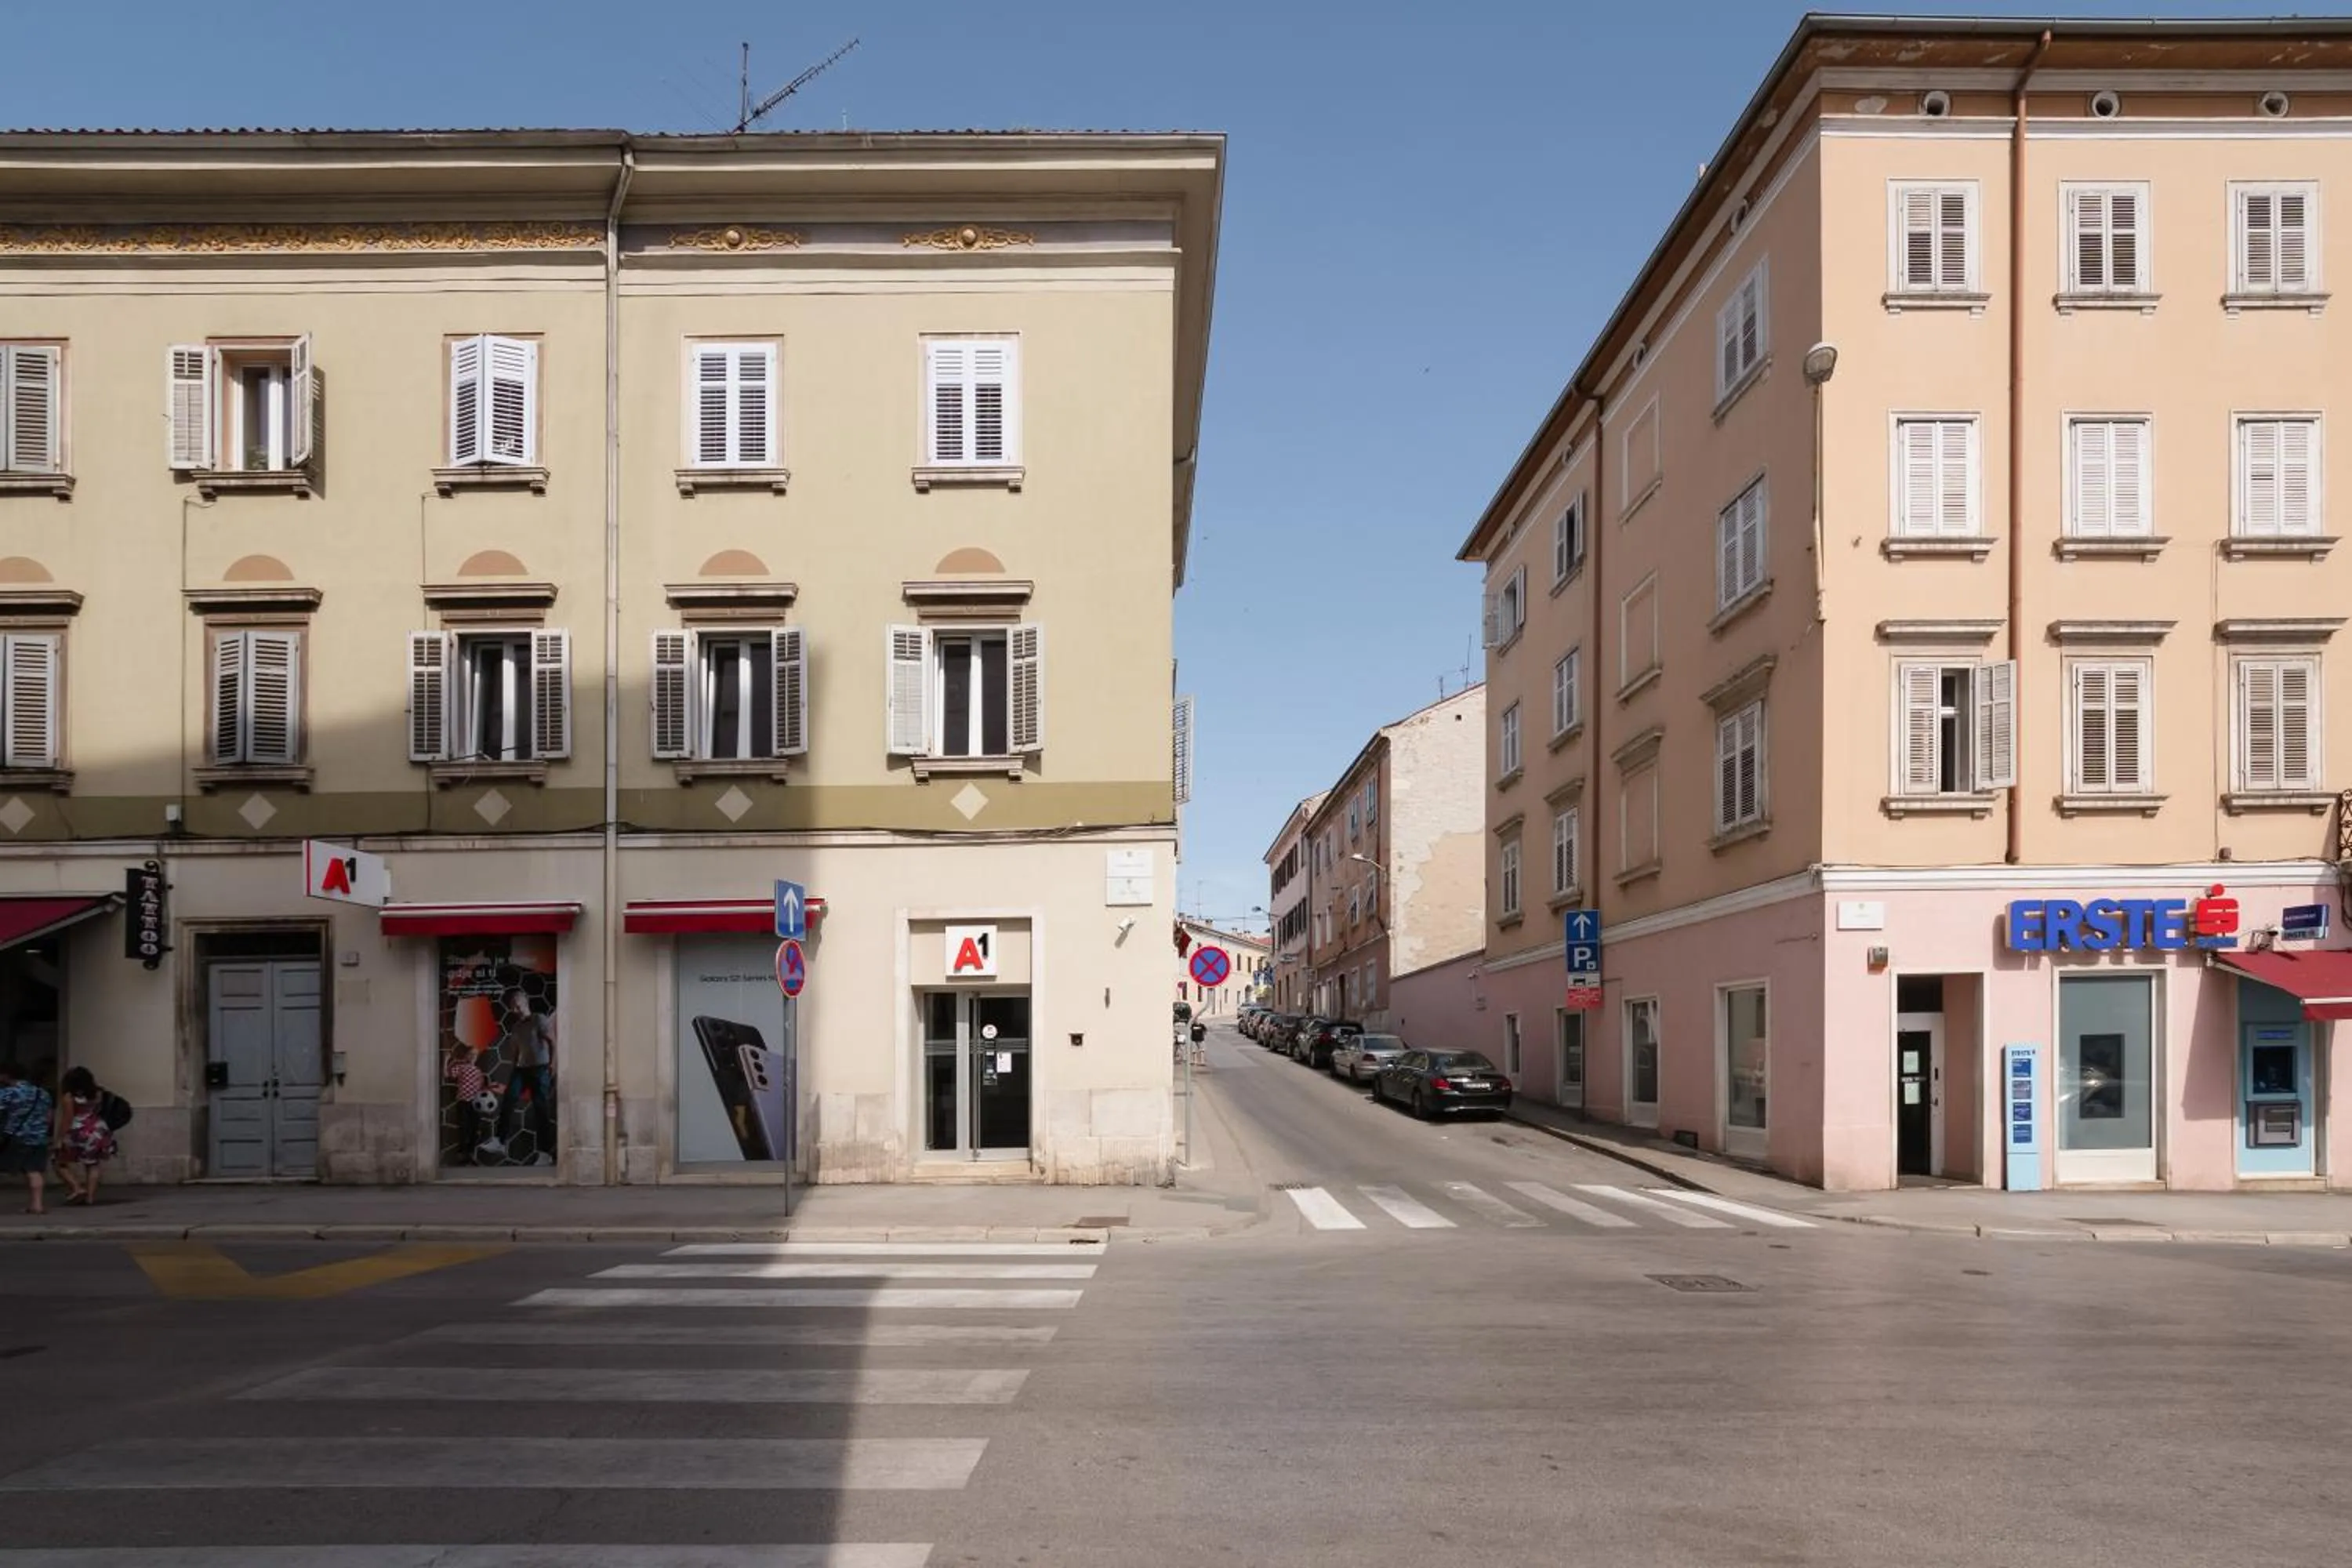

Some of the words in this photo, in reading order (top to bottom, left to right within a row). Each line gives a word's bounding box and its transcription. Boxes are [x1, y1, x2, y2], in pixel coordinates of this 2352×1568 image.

[321, 857, 357, 895] A1
[140, 876, 159, 955] TATTOO
[2011, 898, 2187, 950] ERSTE
[953, 932, 989, 973] A1
[1573, 947, 1592, 968] P
